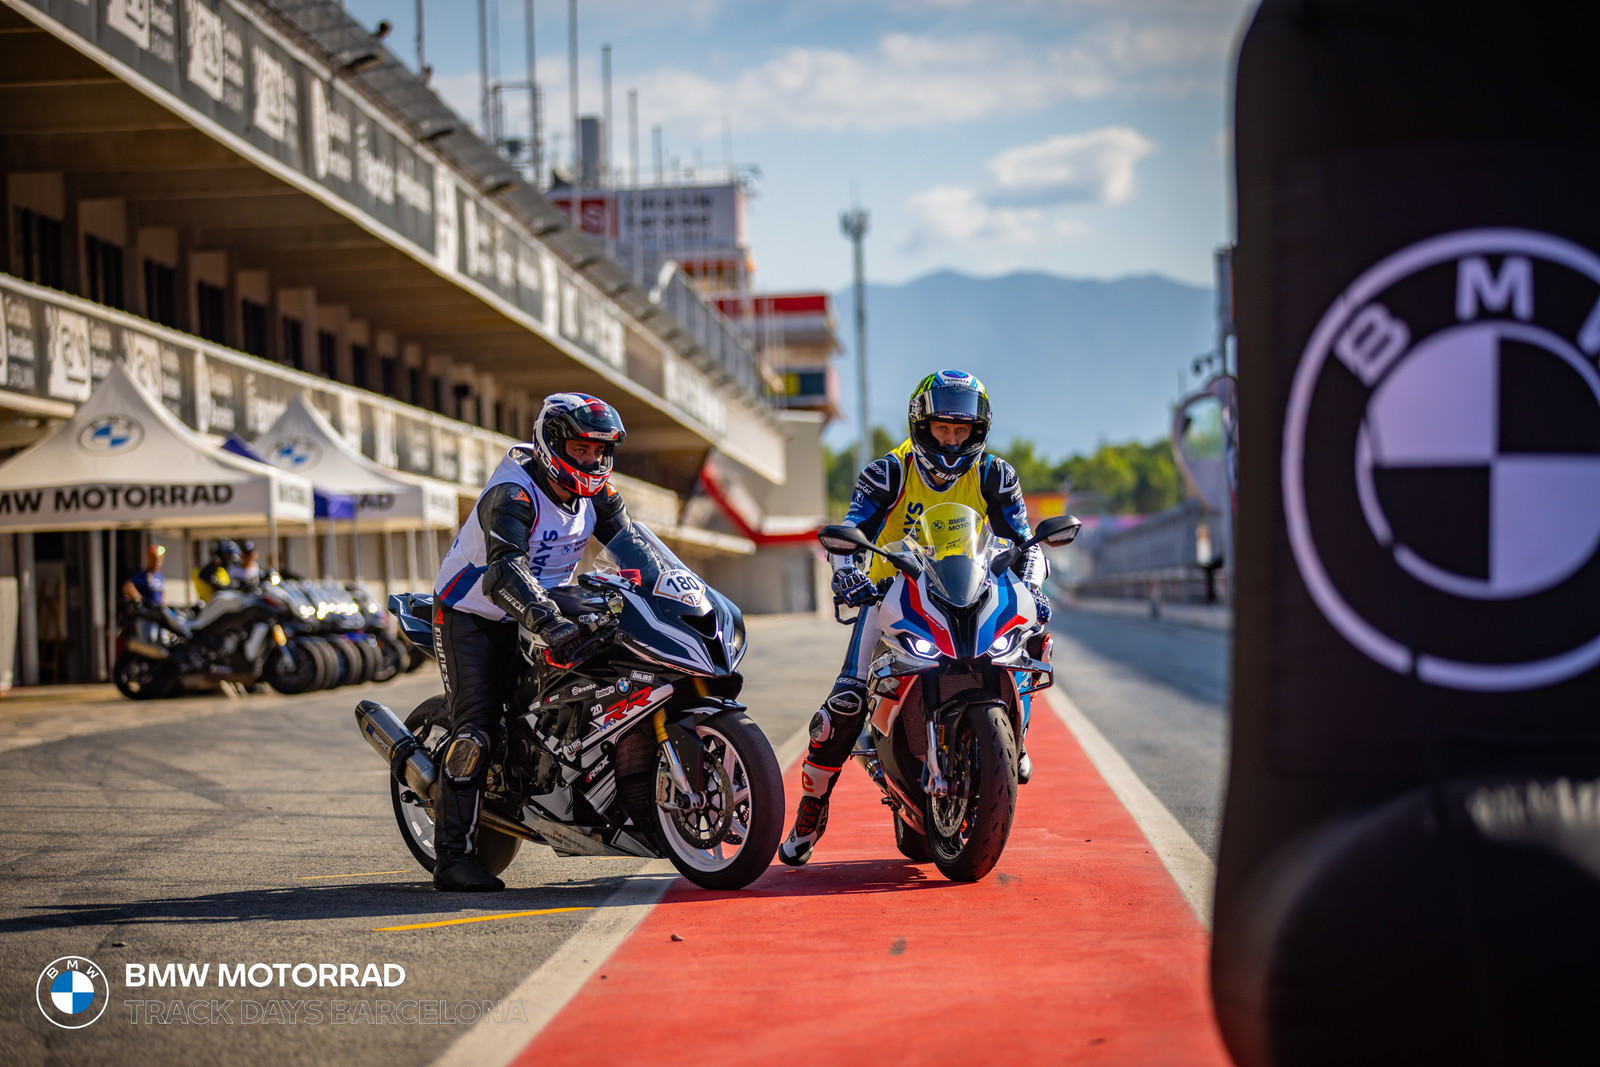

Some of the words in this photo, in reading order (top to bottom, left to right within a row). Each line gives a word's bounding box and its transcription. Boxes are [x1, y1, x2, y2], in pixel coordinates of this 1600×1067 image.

[1334, 256, 1600, 388] BM
[53, 484, 234, 514] MOTORRAD
[948, 516, 967, 525] BMW
[666, 575, 700, 593] 180
[603, 686, 653, 724] RR
